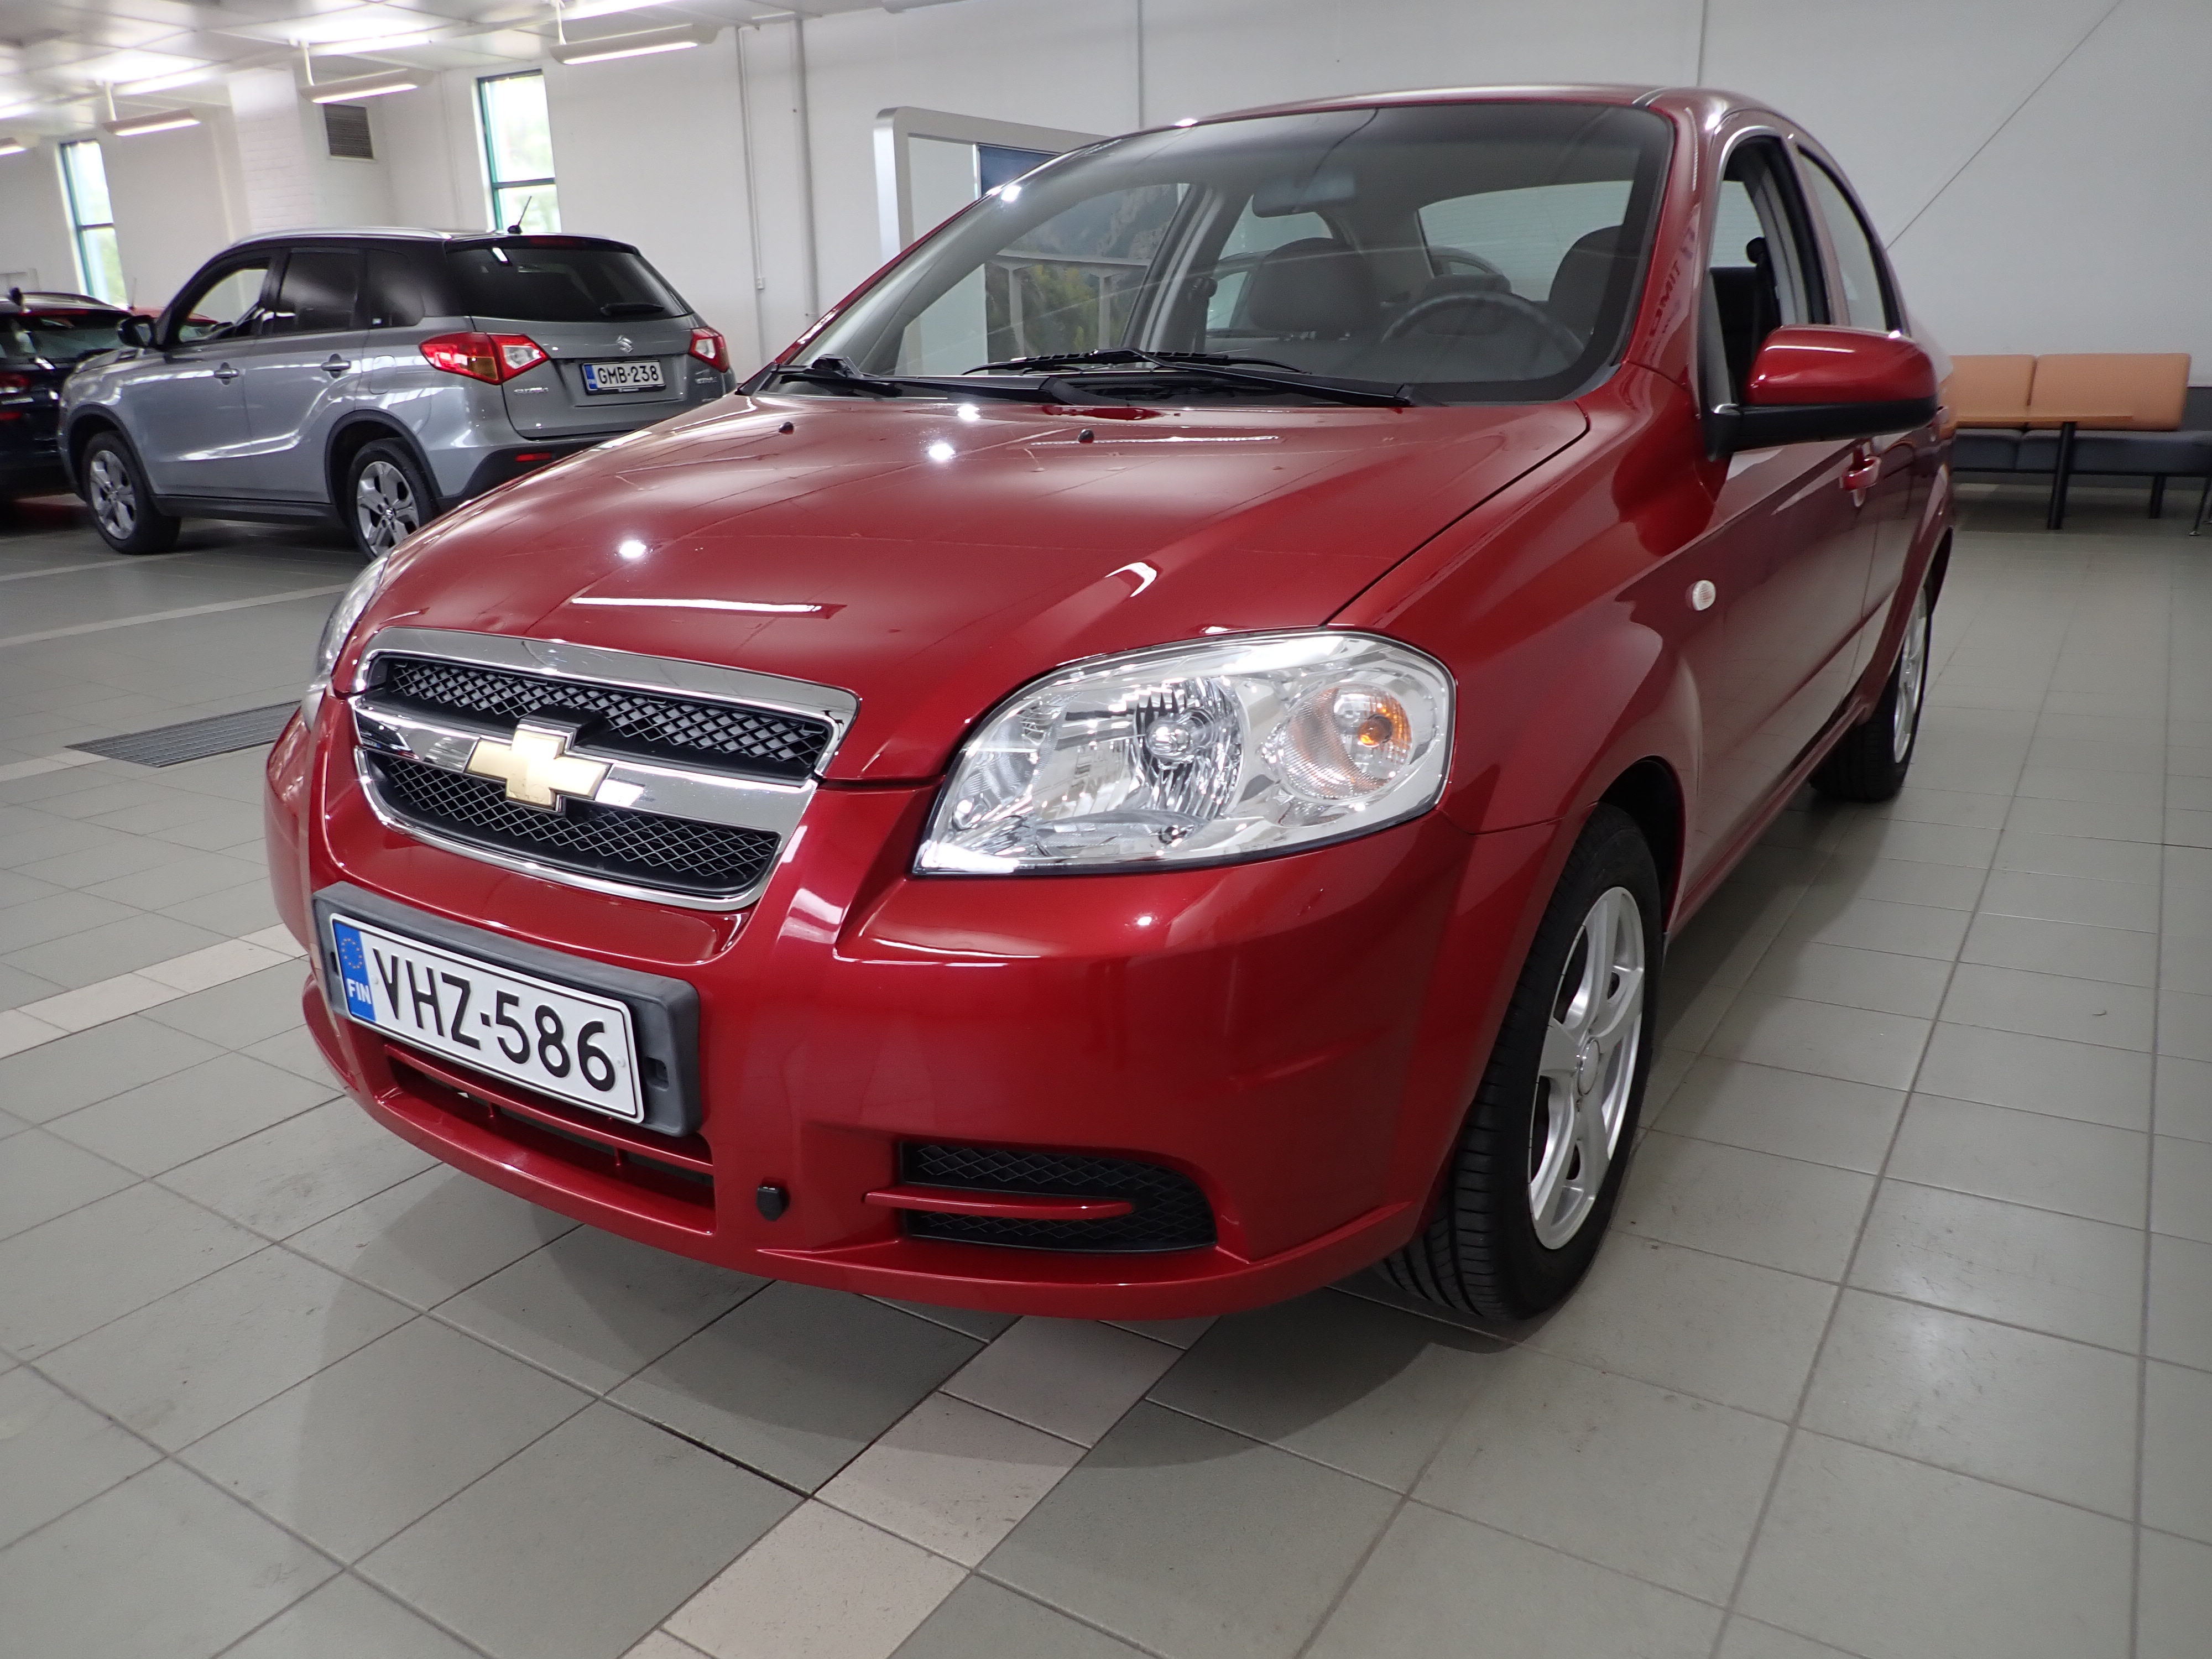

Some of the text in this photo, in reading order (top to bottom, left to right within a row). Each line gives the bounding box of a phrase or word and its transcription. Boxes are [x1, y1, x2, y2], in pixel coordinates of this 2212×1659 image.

[598, 365, 659, 384] GMB-238
[347, 978, 372, 1004] FIN
[372, 947, 616, 1092] VHZ-586
